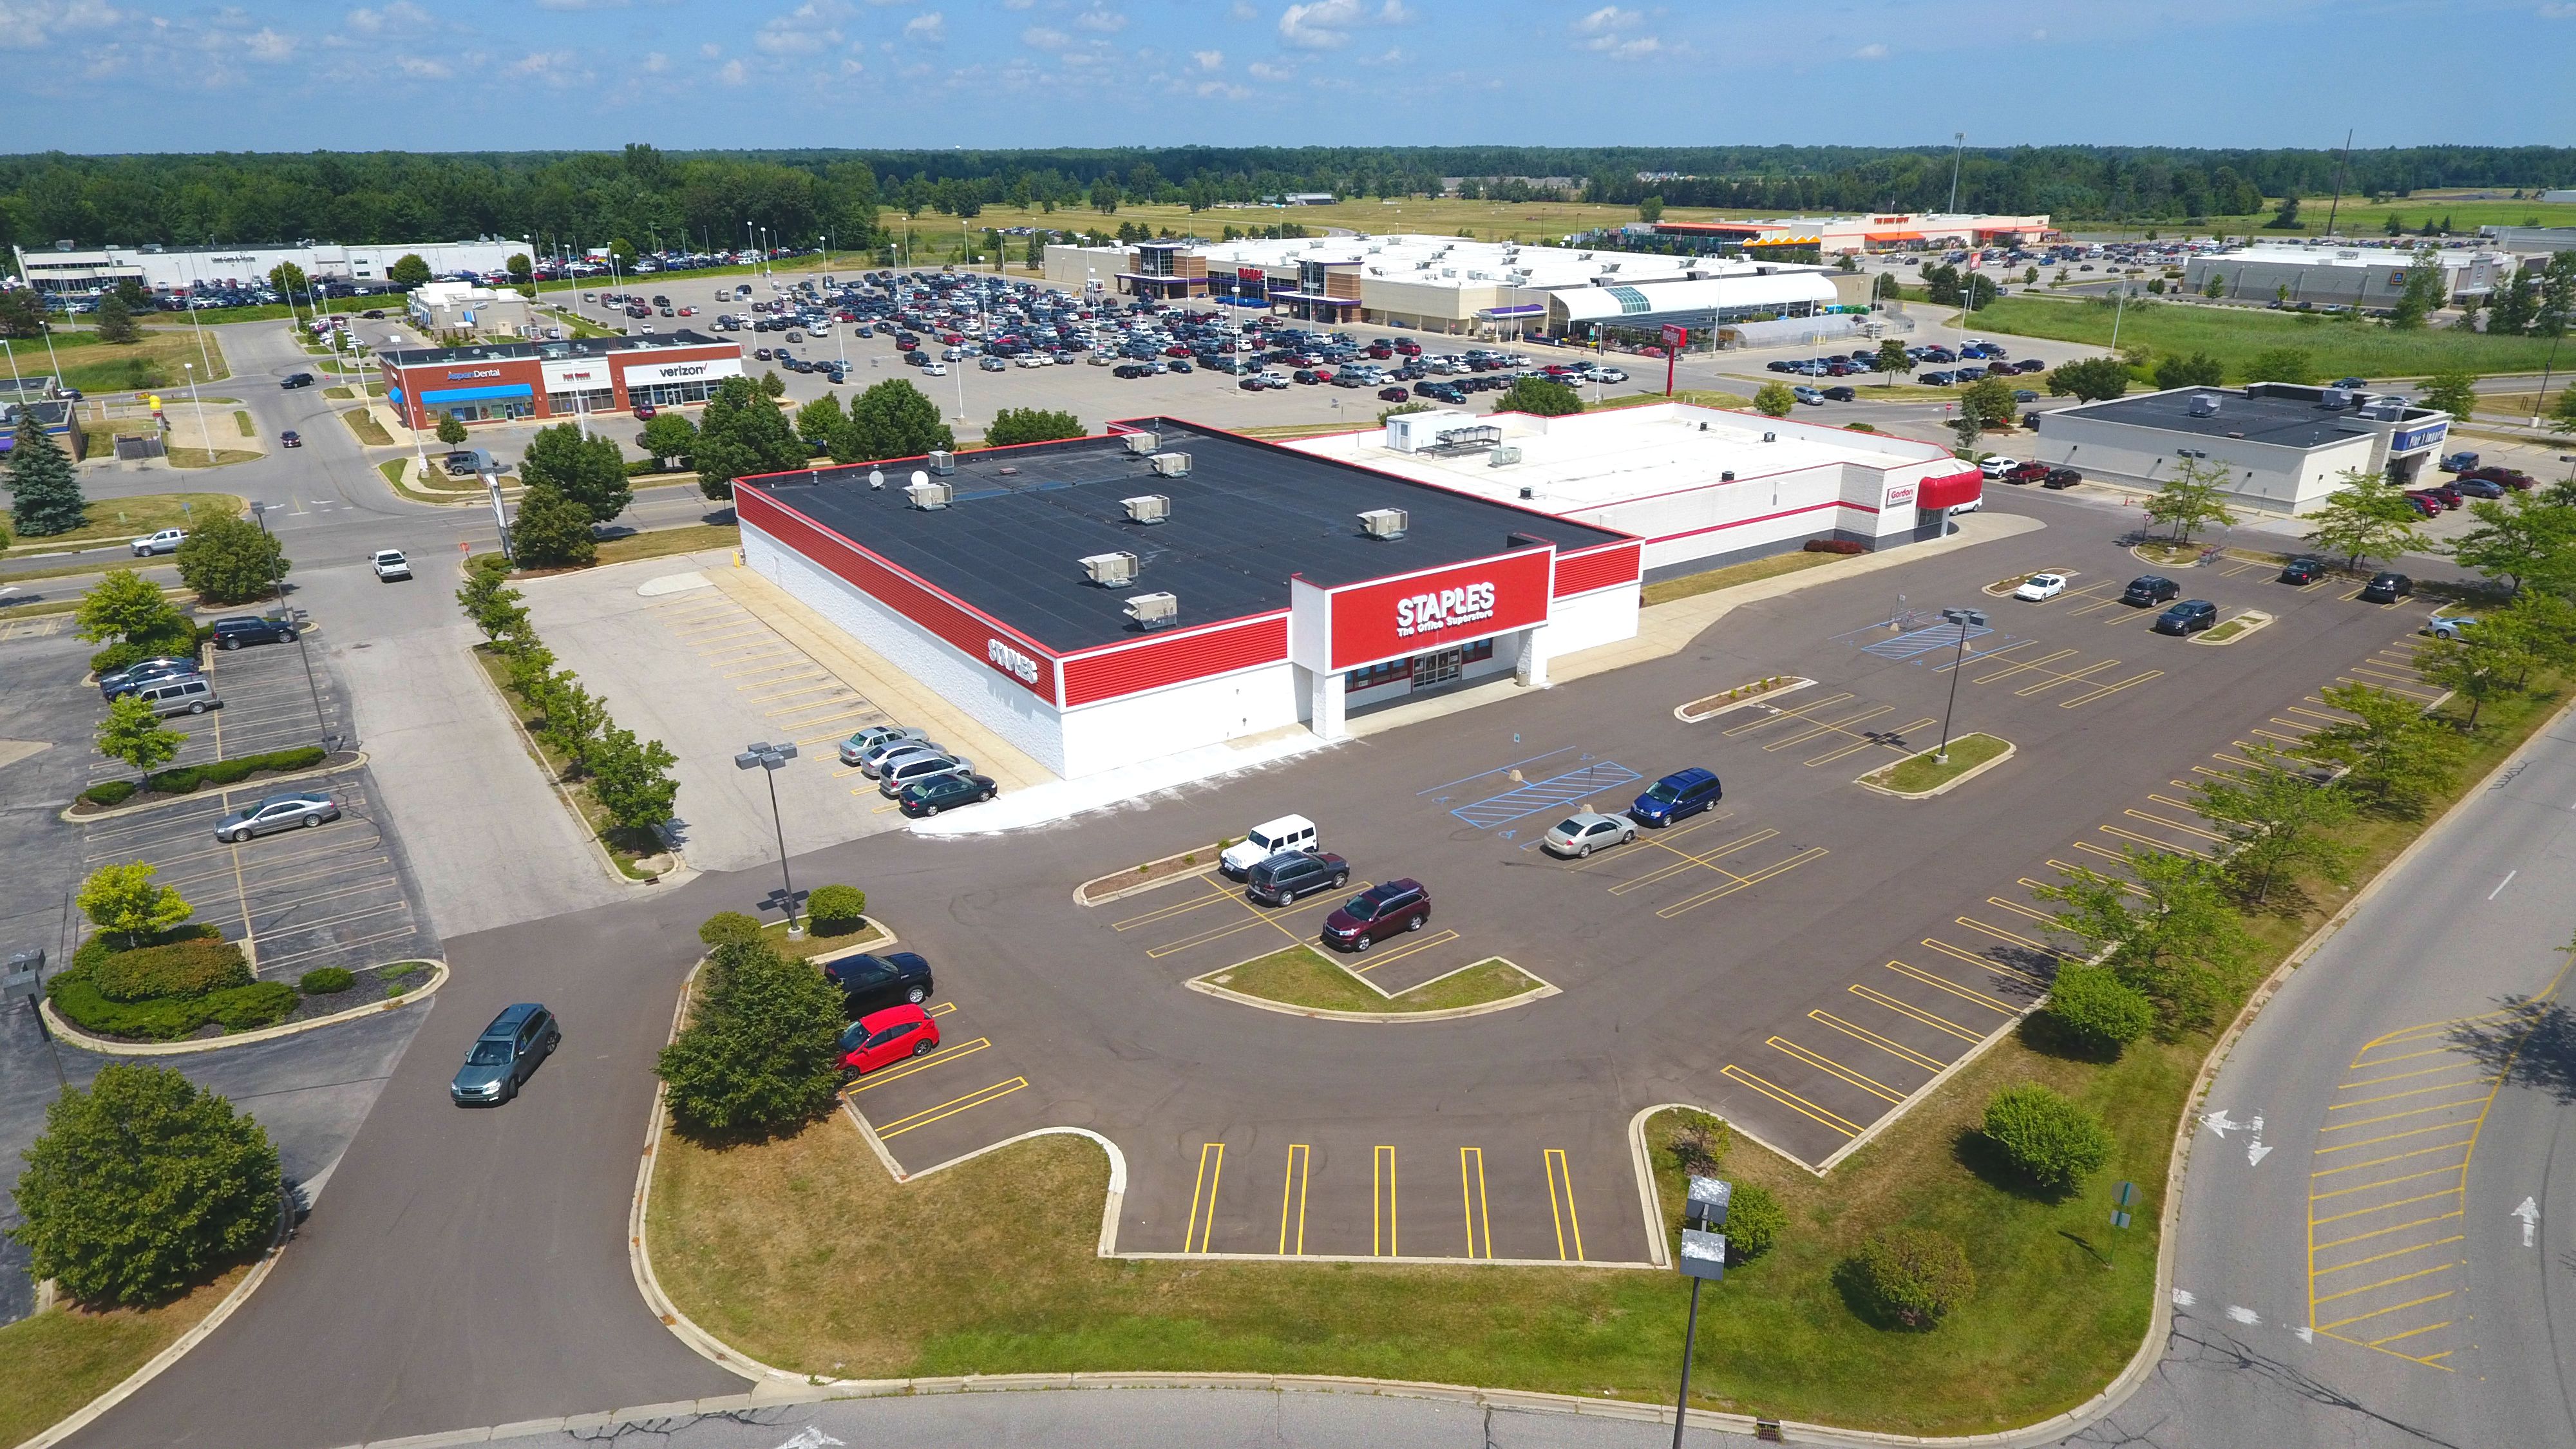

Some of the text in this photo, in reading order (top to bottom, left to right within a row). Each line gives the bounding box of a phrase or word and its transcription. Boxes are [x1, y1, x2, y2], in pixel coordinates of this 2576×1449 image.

[659, 365, 703, 377] verizon
[1891, 488, 1913, 498] Gordon
[1396, 582, 1495, 627] STAPLES
[1396, 609, 1493, 637] The Office Superstore
[988, 638, 1038, 684] STAPLES
